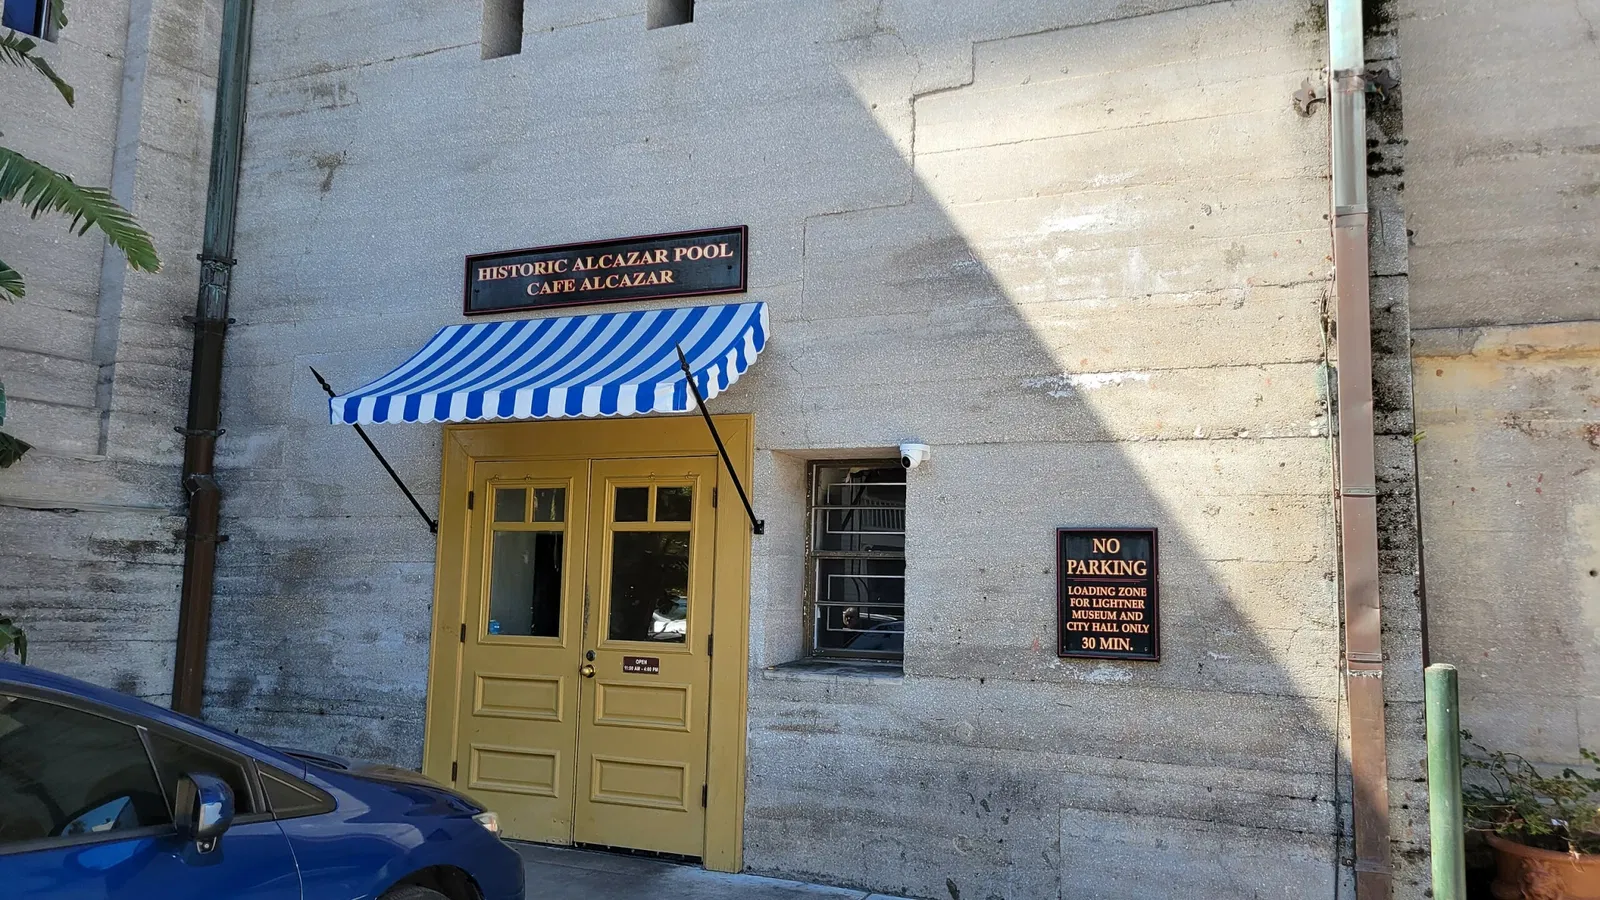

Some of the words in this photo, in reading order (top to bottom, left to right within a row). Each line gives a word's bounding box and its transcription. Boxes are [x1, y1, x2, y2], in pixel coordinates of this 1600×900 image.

[478, 259, 568, 281] HISTORIC
[571, 249, 669, 272] ALCAZAR
[674, 243, 734, 261] POOL
[526, 279, 576, 296] CAFE
[580, 270, 674, 291] ALCAZAR
[1093, 538, 1120, 553] NO
[1067, 560, 1147, 575] PARKING
[1067, 586, 1116, 596] LOADING
[1118, 587, 1147, 597] ZONE
[1069, 598, 1091, 607] FOR
[1092, 599, 1145, 609] LIGHTNER
[1071, 610, 1118, 620] MUSEUM
[1119, 612, 1143, 621] AND
[1066, 622, 1090, 631] CITY
[1092, 623, 1119, 632] HALL
[1121, 624, 1150, 633] ONLY
[1081, 637, 1096, 649] 30
[1100, 638, 1134, 651] MIN.
